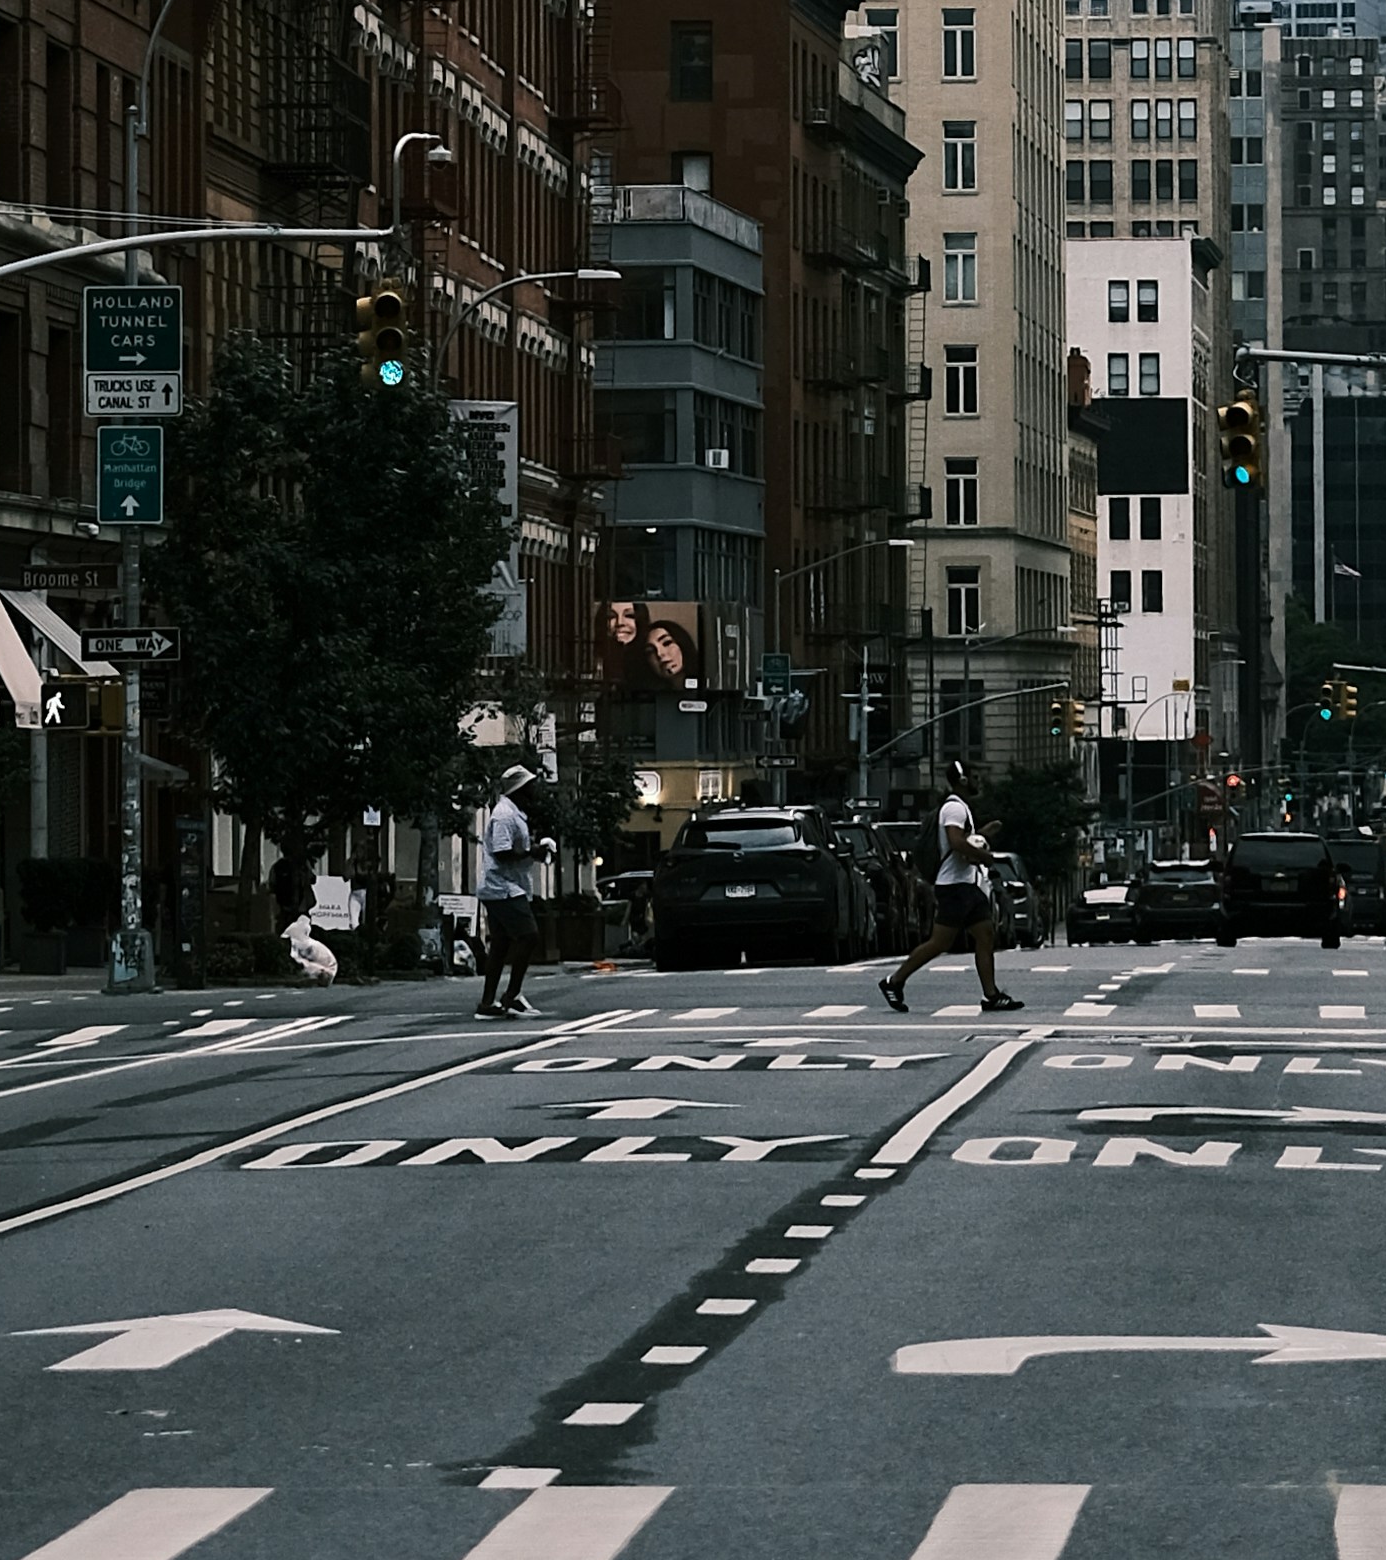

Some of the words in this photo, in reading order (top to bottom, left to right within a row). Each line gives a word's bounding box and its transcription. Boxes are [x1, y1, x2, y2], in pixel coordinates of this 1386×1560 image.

[93, 296, 174, 309] HOLLAND
[99, 315, 168, 328] TUNNEL
[110, 334, 156, 347] CARS
[94, 380, 133, 392] TRUCKS
[136, 380, 156, 392] USE
[98, 397, 133, 409] CANAL
[138, 397, 150, 408] ST
[103, 464, 157, 472] Manhattan
[114, 479, 147, 489] Bridge
[23, 571, 79, 587] Broome
[85, 570, 99, 587] St
[95, 639, 123, 651] ONE
[136, 638, 164, 650] WAY
[514, 1054, 950, 1072] ONLY
[240, 1135, 849, 1169] ONLY
